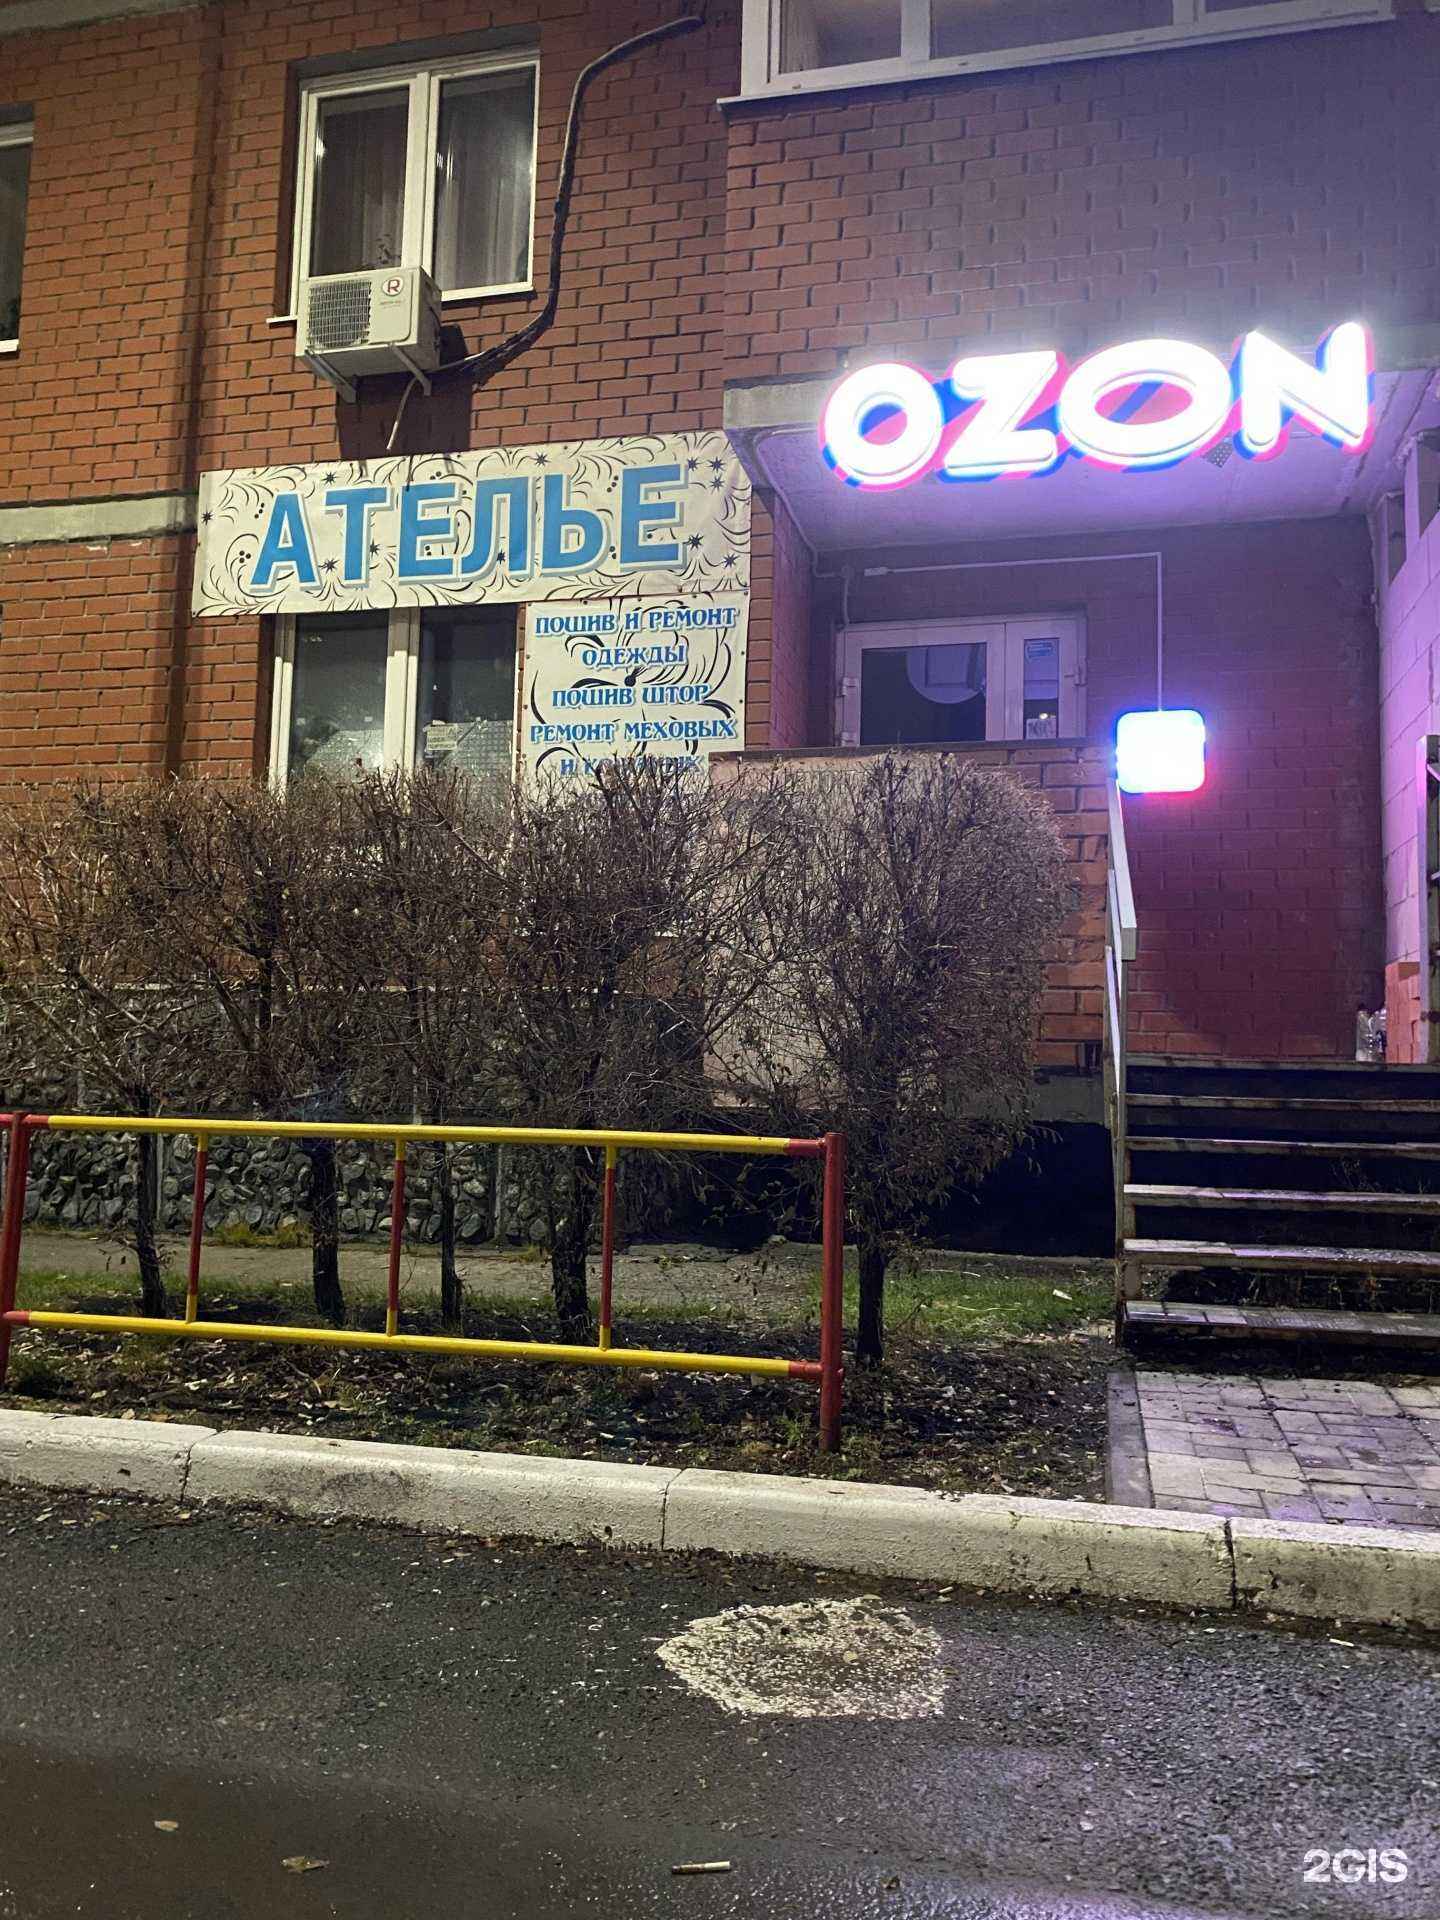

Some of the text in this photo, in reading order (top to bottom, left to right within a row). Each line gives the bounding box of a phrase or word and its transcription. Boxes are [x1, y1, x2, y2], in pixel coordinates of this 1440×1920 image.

[821, 321, 1373, 490] OZON
[249, 464, 688, 592] АТЕЛЬЕ
[535, 607, 737, 634] ПОШИВ И РЕМОНТ
[581, 645, 687, 668] ОДЕЖДЫ
[552, 684, 709, 707] ПОШИВ ШТОР
[530, 719, 736, 742] РЕМОНТ МЕХОВЫХ
